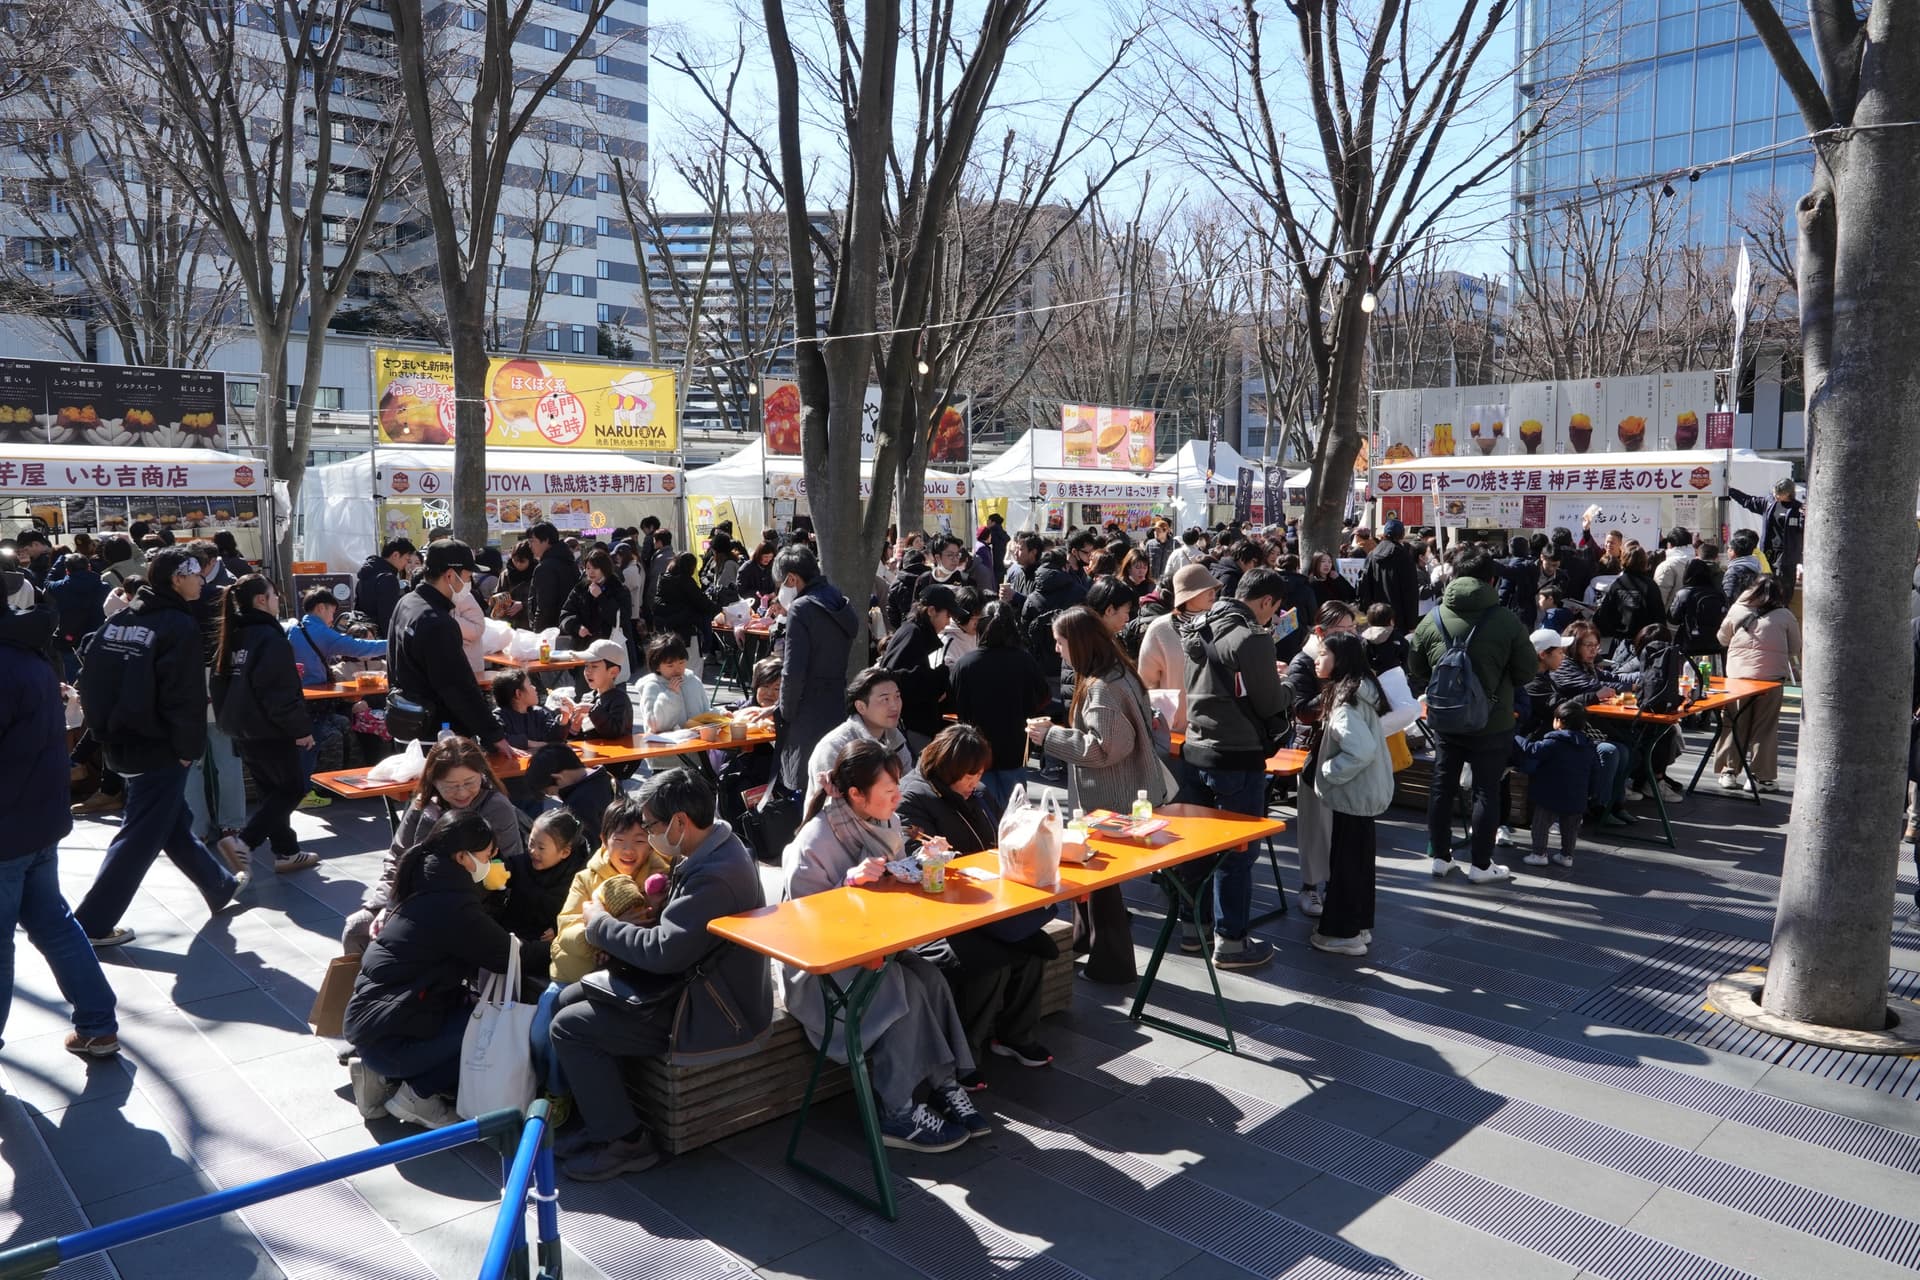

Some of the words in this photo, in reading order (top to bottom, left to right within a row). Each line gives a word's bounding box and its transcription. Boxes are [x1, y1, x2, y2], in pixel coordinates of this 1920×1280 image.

[115, 384, 163, 392] シルクスイート
[511, 376, 567, 393] ほくほく系
[541, 396, 577, 417] 鳴門
[546, 418, 582, 439] 金時
[594, 424, 667, 438] NARUTOYA
[65, 464, 189, 488] いも吉商店
[485, 475, 531, 491] UTOYA
[1422, 470, 1542, 492] 日本一の焼き芋屋
[1548, 467, 1684, 491] 神戸芋屋志のもと
[1068, 483, 1123, 497] 焼き芋スイーツ
[1125, 485, 1161, 498] ほっこり芋
